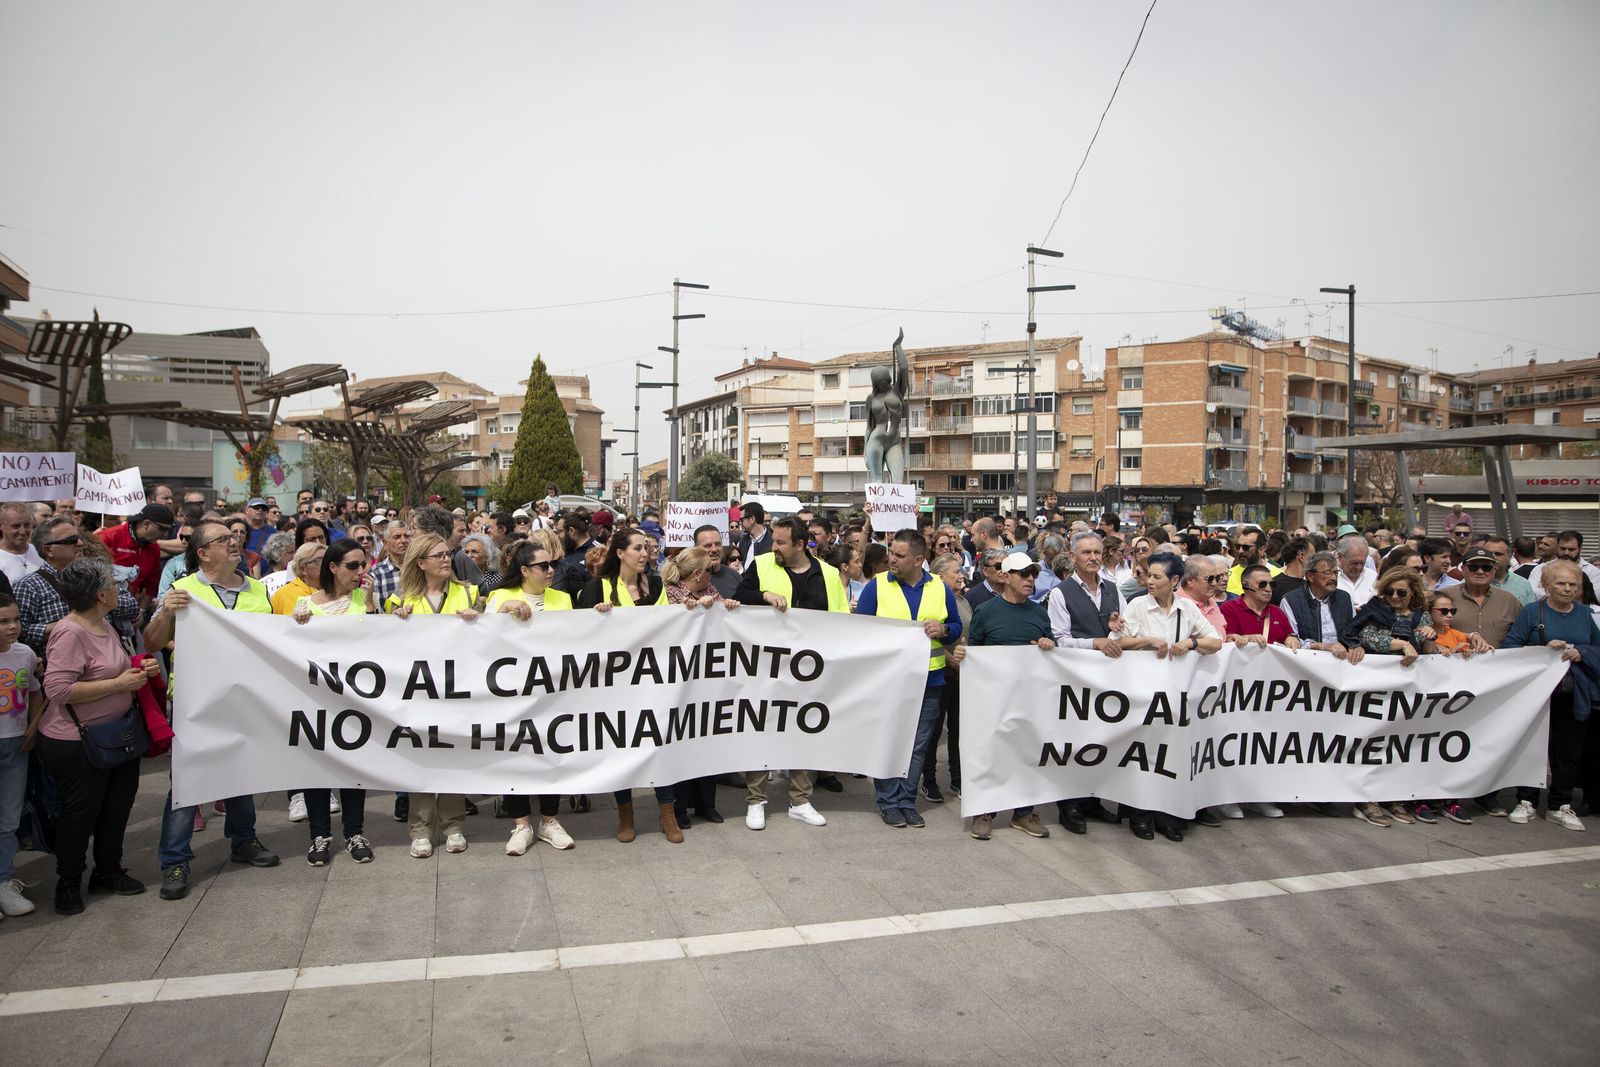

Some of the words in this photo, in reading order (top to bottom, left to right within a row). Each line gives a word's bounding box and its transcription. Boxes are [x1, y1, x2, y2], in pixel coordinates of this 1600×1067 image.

[2, 455, 31, 471] NO
[38, 455, 65, 471] AL
[0, 473, 74, 490] CAMPAMENTO
[82, 467, 102, 485] NO
[108, 478, 125, 490] AL
[1526, 478, 1580, 486] KIOSCO
[869, 486, 885, 497] NO
[890, 487, 904, 498] AL
[668, 503, 683, 515] NO
[667, 520, 682, 530] NO
[683, 522, 695, 530] AL
[307, 659, 386, 699] NO
[402, 659, 472, 701] AL
[485, 641, 825, 698] CAMPAMENTO
[1058, 684, 1130, 723] NO
[1142, 691, 1191, 727] AL
[1196, 678, 1476, 721] CAMPAMENTO
[288, 709, 372, 751] NO
[386, 725, 455, 749] AL
[470, 698, 830, 755] HACINAMIENTO
[1038, 742, 1108, 767] NO
[1117, 741, 1177, 780] AL
[1189, 730, 1471, 782] HACINAMIENTO
